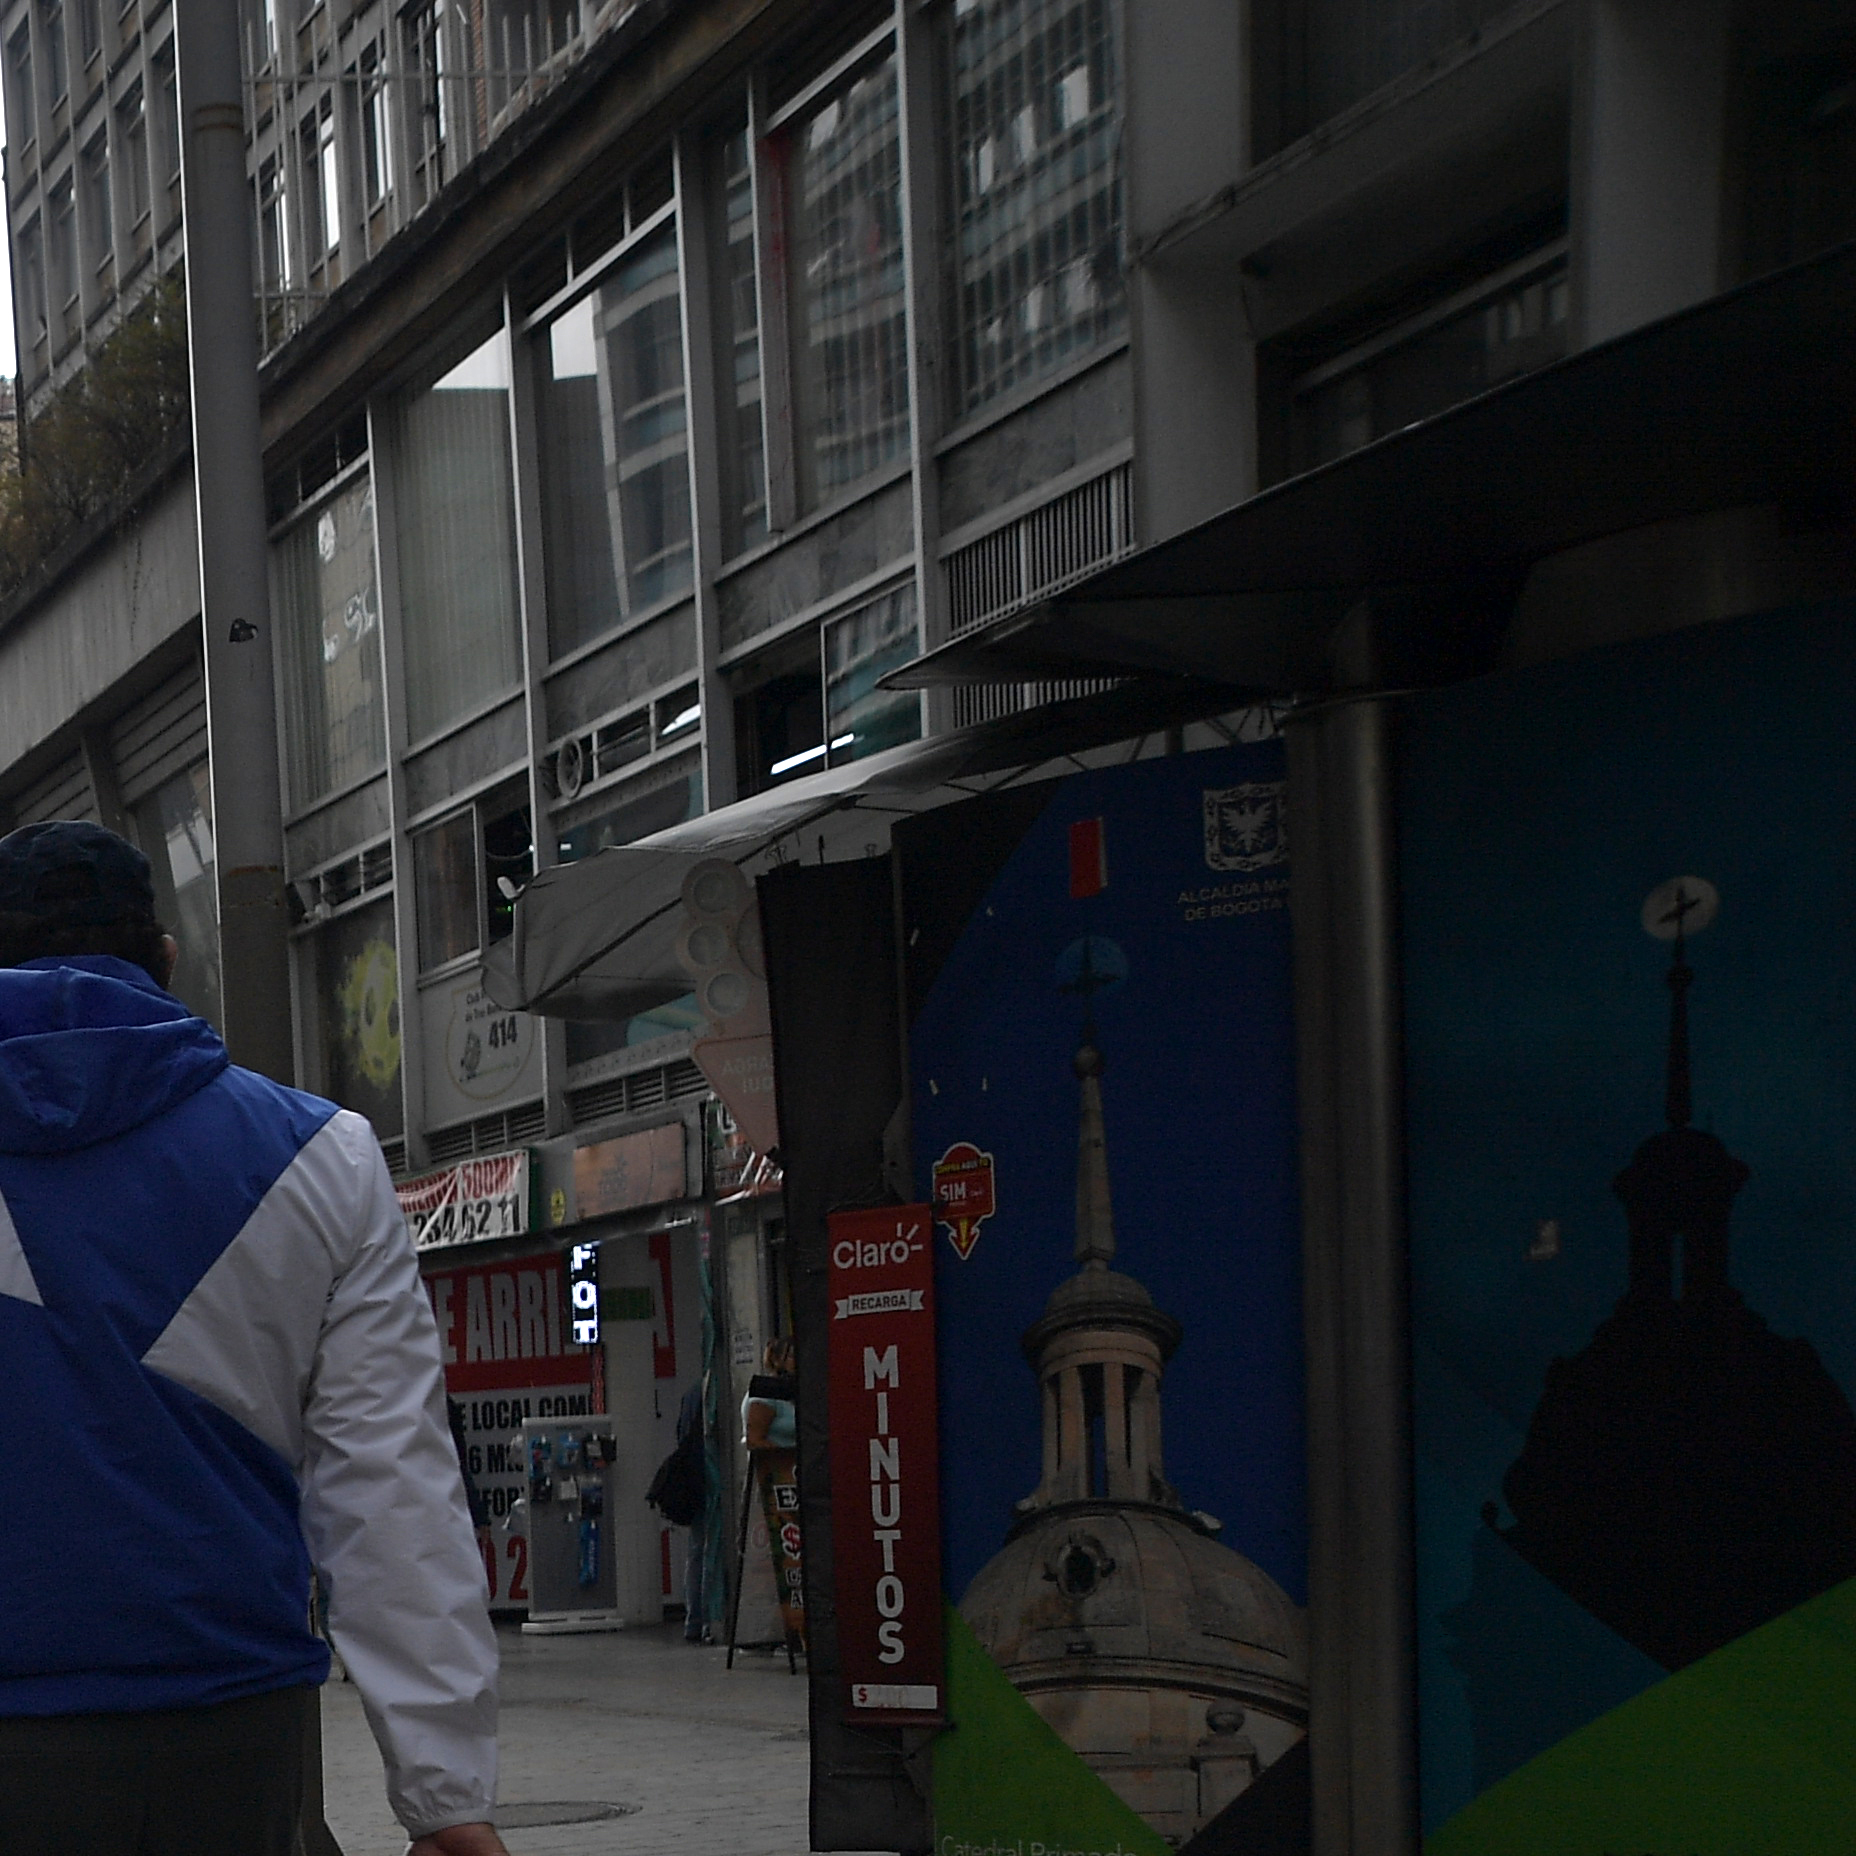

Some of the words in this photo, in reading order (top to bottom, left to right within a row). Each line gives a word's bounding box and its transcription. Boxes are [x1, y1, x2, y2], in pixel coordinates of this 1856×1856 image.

[489, 1015, 518, 1049] 414
[940, 1181, 966, 1201] SIM
[833, 1236, 912, 1269] Claro
[435, 1277, 456, 1365] E
[465, 1266, 565, 1364] ARRI
[852, 1294, 907, 1311] RECARGA
[864, 1346, 905, 1664] MINUTOS
